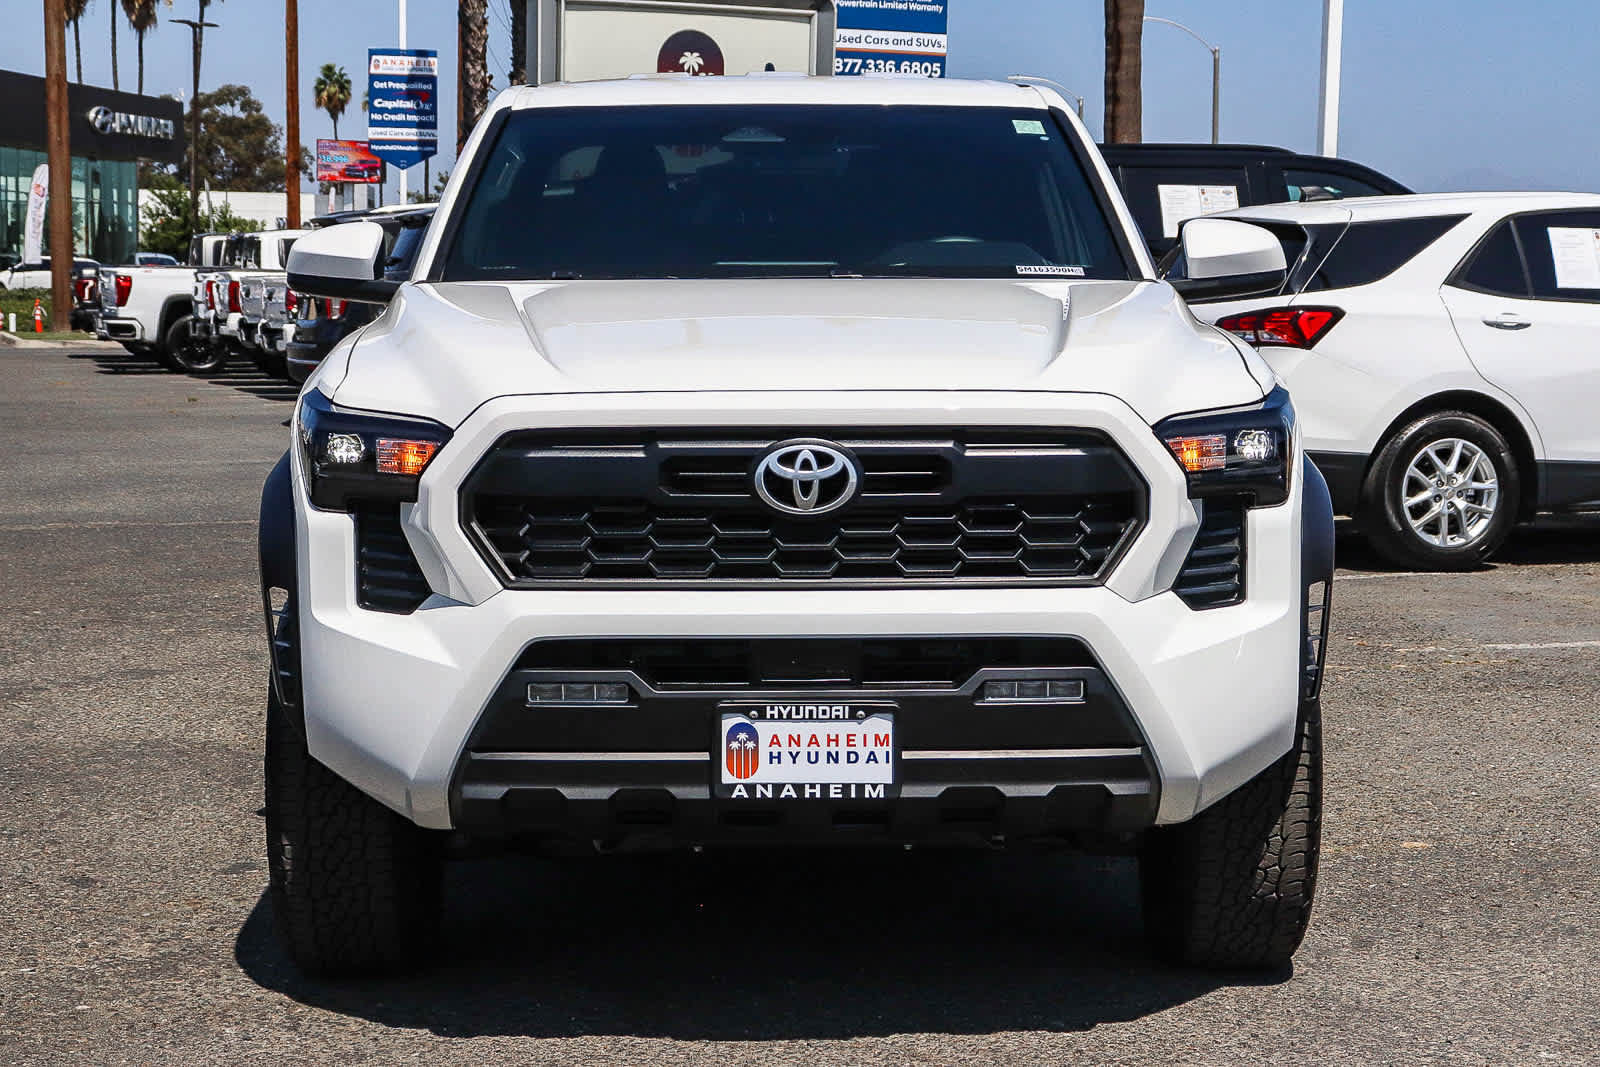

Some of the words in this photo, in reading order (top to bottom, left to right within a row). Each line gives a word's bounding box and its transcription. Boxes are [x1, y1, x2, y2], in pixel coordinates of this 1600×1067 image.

[836, 0, 878, 8] owertrain
[879, 1, 908, 9] Limited
[909, 2, 943, 14] Warranty
[864, 35, 889, 45] Cars
[892, 37, 913, 47] and
[916, 38, 945, 48] SUVs.
[383, 58, 436, 67] ANAHEIM
[835, 58, 941, 78] 877.336.6805
[373, 81, 387, 89] Get
[388, 82, 432, 90] Prequalified
[373, 99, 414, 110] Capital
[383, 113, 405, 121] Credit
[766, 705, 849, 719] HYUNDAI
[768, 733, 890, 747] ANAHEIM
[768, 750, 890, 764] HYUNDAI
[730, 783, 885, 799] ANAHEIM
